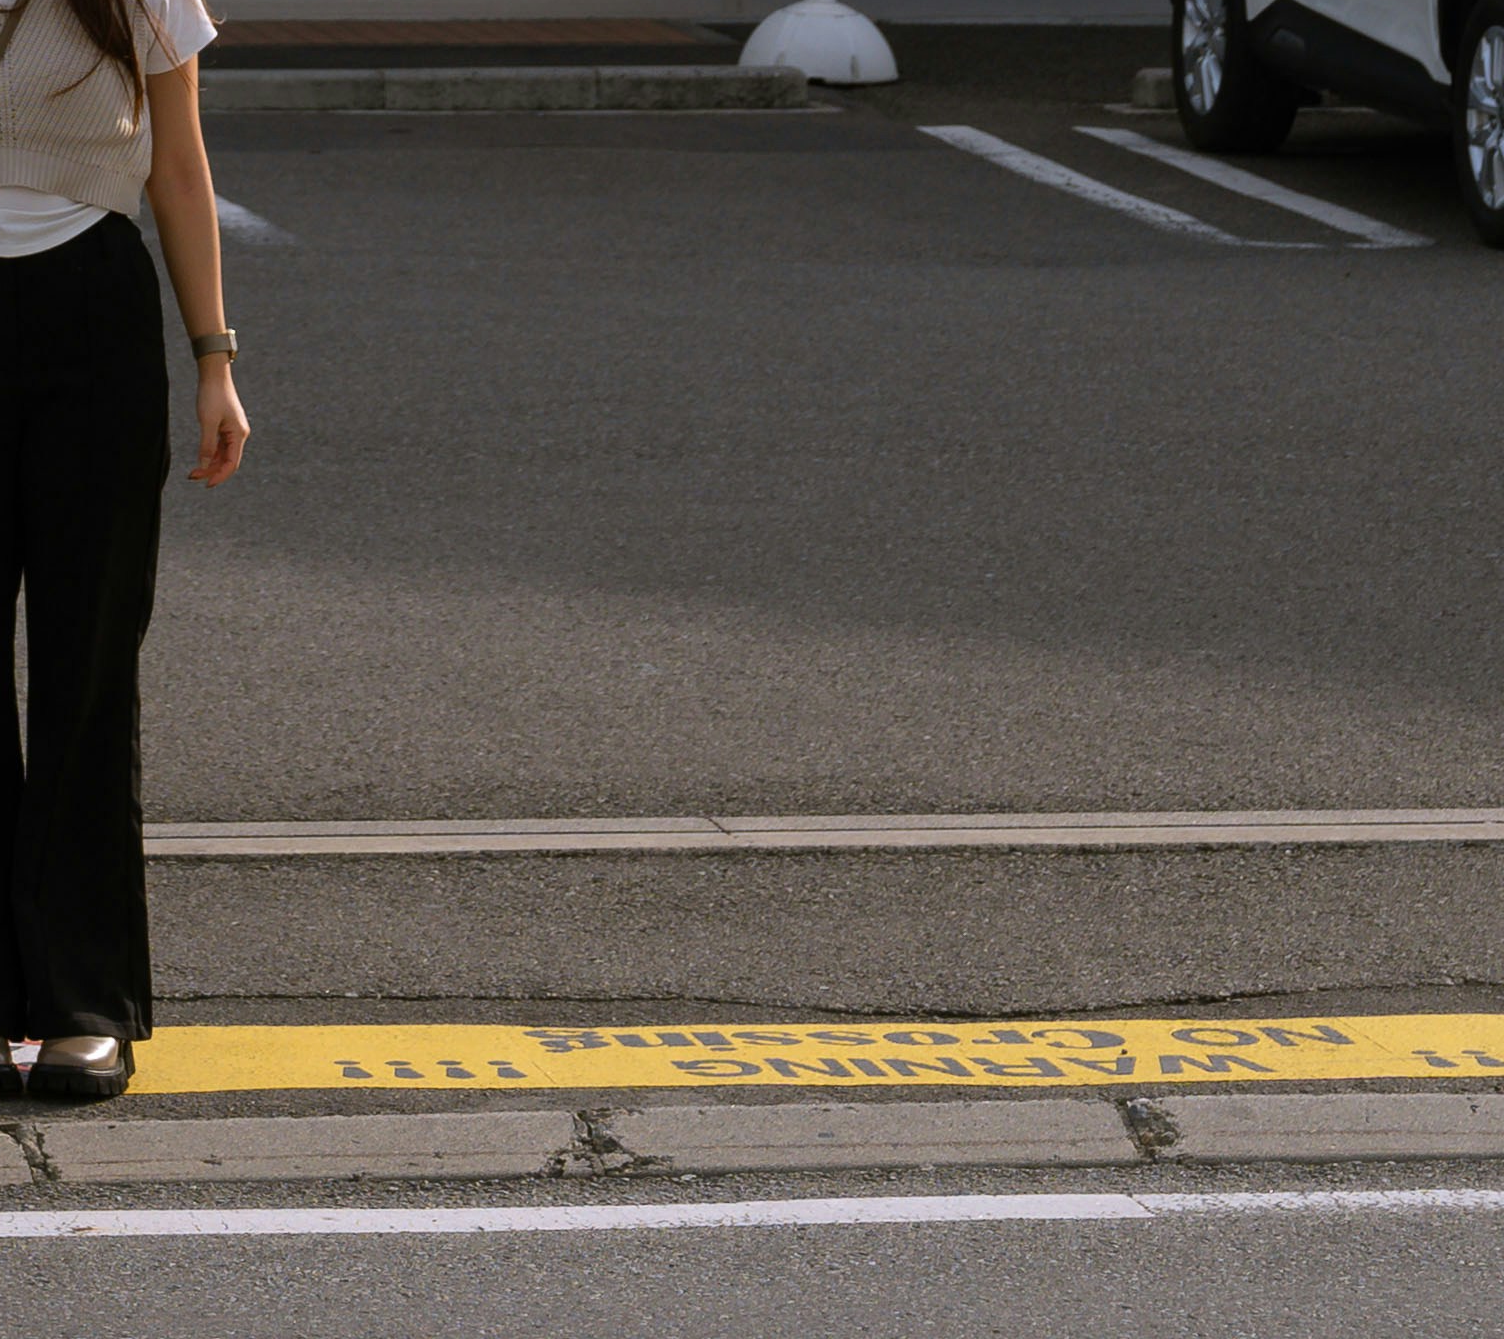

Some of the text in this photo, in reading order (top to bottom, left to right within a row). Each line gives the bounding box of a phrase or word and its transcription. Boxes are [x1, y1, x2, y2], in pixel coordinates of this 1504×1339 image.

[523, 1024, 1356, 1054] NO Crossing
[671, 1053, 1277, 1079] WARNING
